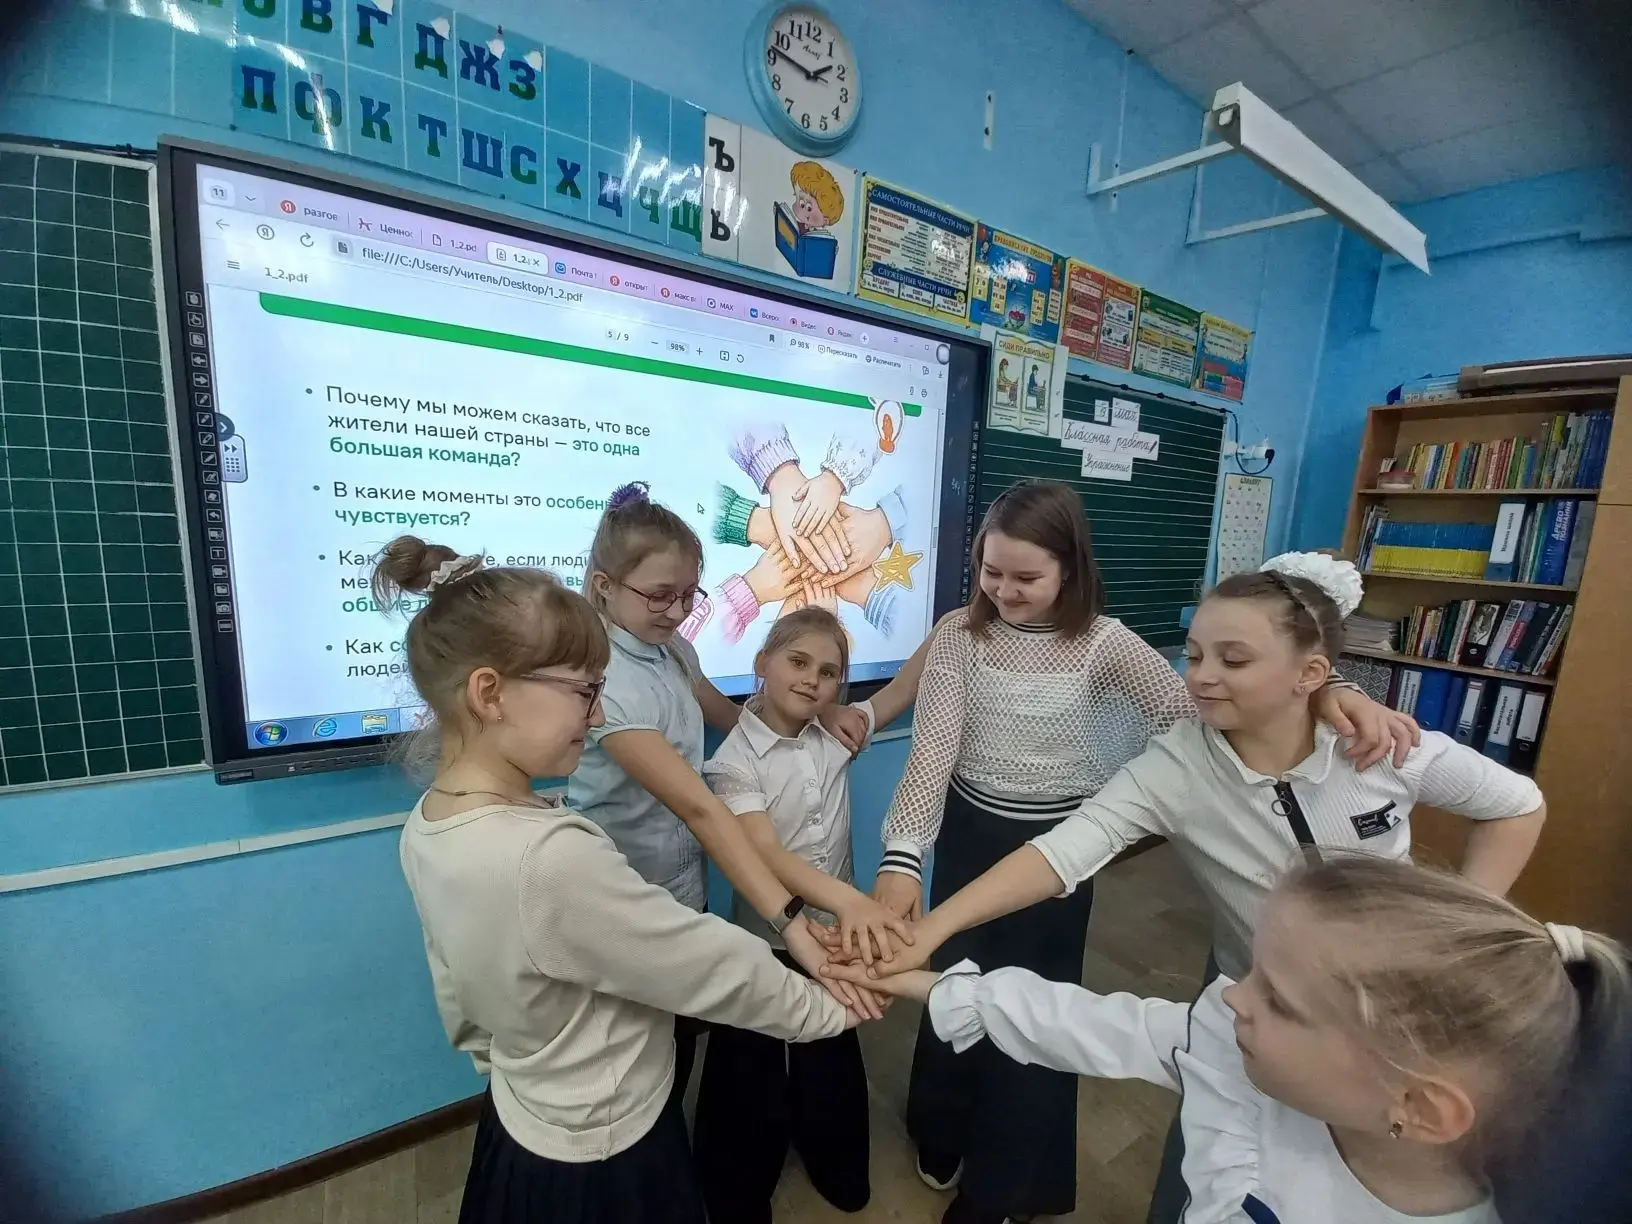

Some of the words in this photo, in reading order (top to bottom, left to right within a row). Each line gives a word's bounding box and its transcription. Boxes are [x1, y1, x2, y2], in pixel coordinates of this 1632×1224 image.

[775, 30, 790, 51] 10
[828, 41, 834, 57] 1
[789, 20, 803, 41] 11
[805, 21, 822, 43] 12
[415, 23, 448, 79] Д
[459, 40, 500, 91] Ж
[509, 60, 537, 100] З
[768, 48, 777, 66] 9
[837, 64, 846, 81] 2
[772, 74, 781, 91] 8
[840, 87, 848, 104] 3
[785, 97, 795, 114] 7
[832, 105, 840, 121] 4
[241, 65, 277, 114] П
[294, 73, 342, 135] Ф
[360, 96, 392, 143] К
[418, 114, 447, 157] Т
[462, 128, 504, 178] Ш
[511, 145, 537, 185] С
[556, 157, 582, 200] Х
[801, 113, 811, 129] 6
[819, 115, 828, 131] 5
[709, 136, 735, 173] Ъ
[213, 187, 224, 197] 11
[710, 208, 731, 242] Ь
[264, 266, 308, 283] 1_2.pdf
[624, 333, 630, 341] 9
[1000, 340, 1015, 351] СИДИ
[326, 385, 410, 413] Почему
[417, 400, 446, 414] мы
[453, 404, 517, 422] можем
[522, 412, 591, 433] сказать,
[595, 420, 621, 433] что
[625, 424, 651, 437] все
[328, 415, 408, 434] жители
[415, 423, 478, 441] нашей
[484, 431, 549, 448] страны
[572, 439, 599, 452] это
[603, 442, 640, 456] одна
[330, 436, 423, 459] большая
[429, 447, 521, 468] команда?
[334, 481, 348, 498] В
[355, 486, 416, 501] какие
[422, 490, 508, 505] моменты
[514, 495, 541, 506] это
[335, 510, 471, 528] чувствуется?
[506, 555, 546, 566] если
[345, 639, 384, 655] Как
